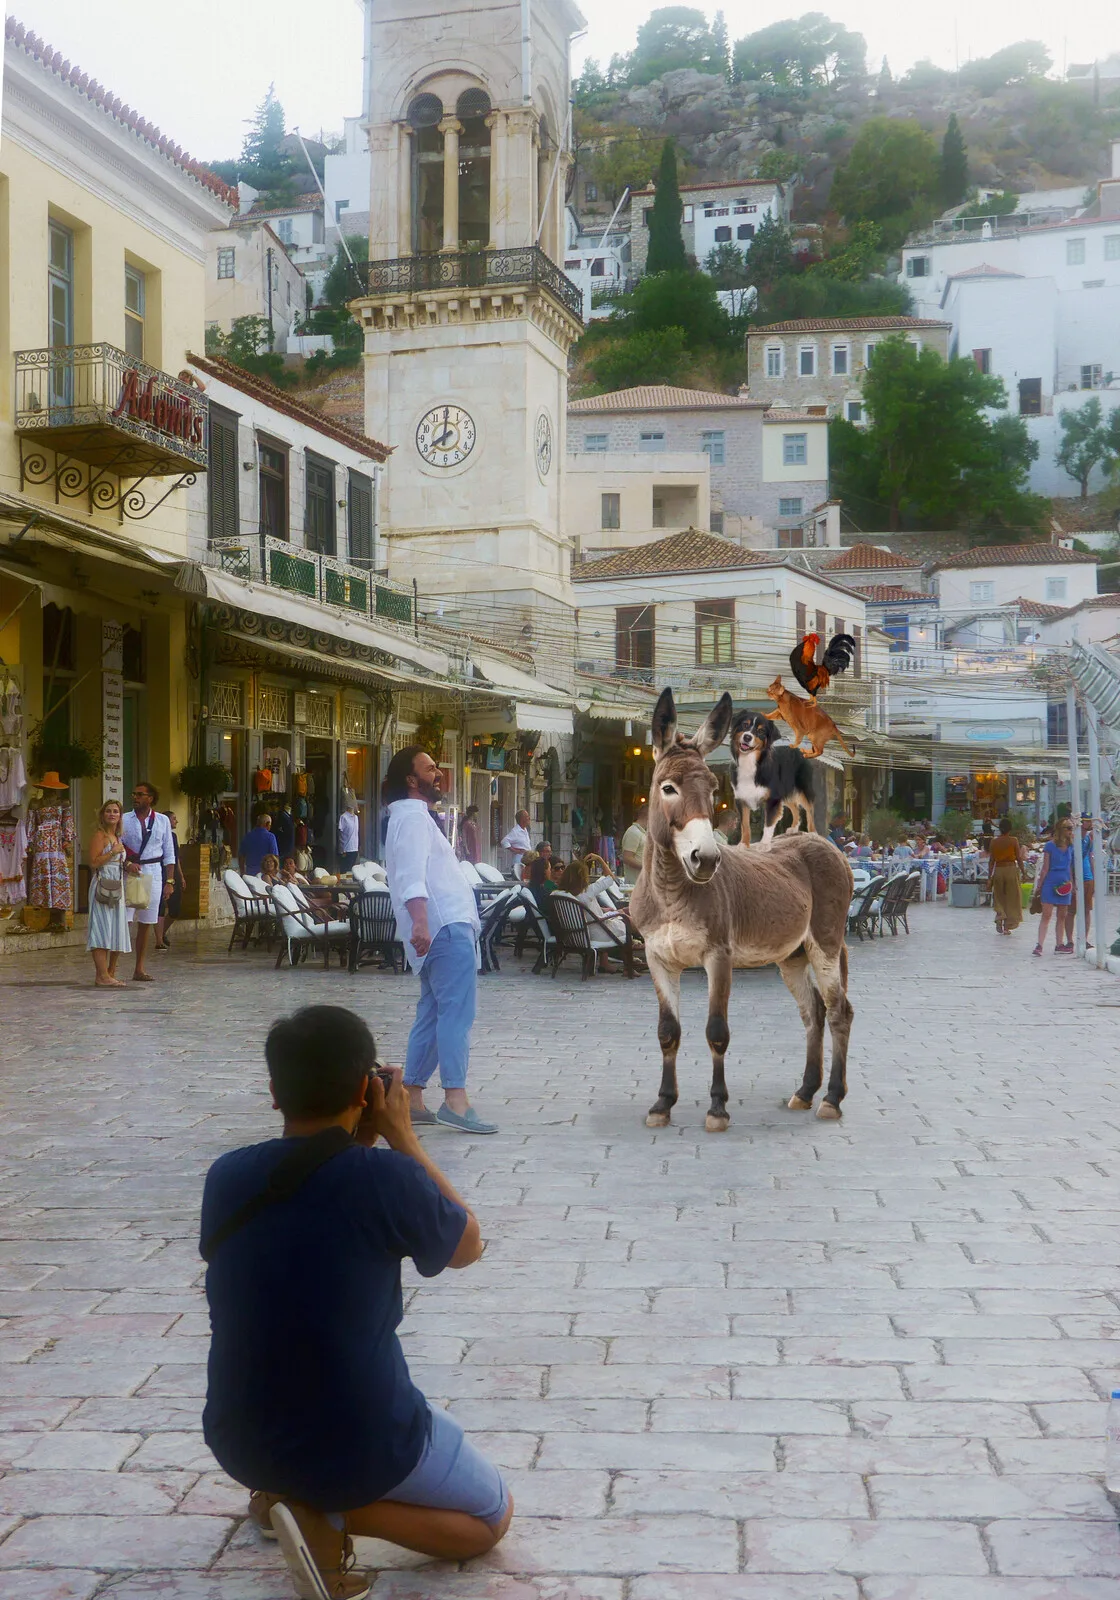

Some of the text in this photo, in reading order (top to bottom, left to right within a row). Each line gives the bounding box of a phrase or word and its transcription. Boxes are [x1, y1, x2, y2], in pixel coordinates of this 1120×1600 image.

[112, 369, 203, 444] Adonis
[432, 414, 438, 422] 11
[423, 424, 430, 433] 10
[464, 420, 468, 429] 2
[420, 434, 425, 443] 9
[467, 430, 472, 439] 3
[424, 444, 428, 452] 8
[463, 442, 468, 450] 4
[433, 452, 436, 460] 7
[443, 454, 448, 463] 6
[454, 451, 459, 459] 5
